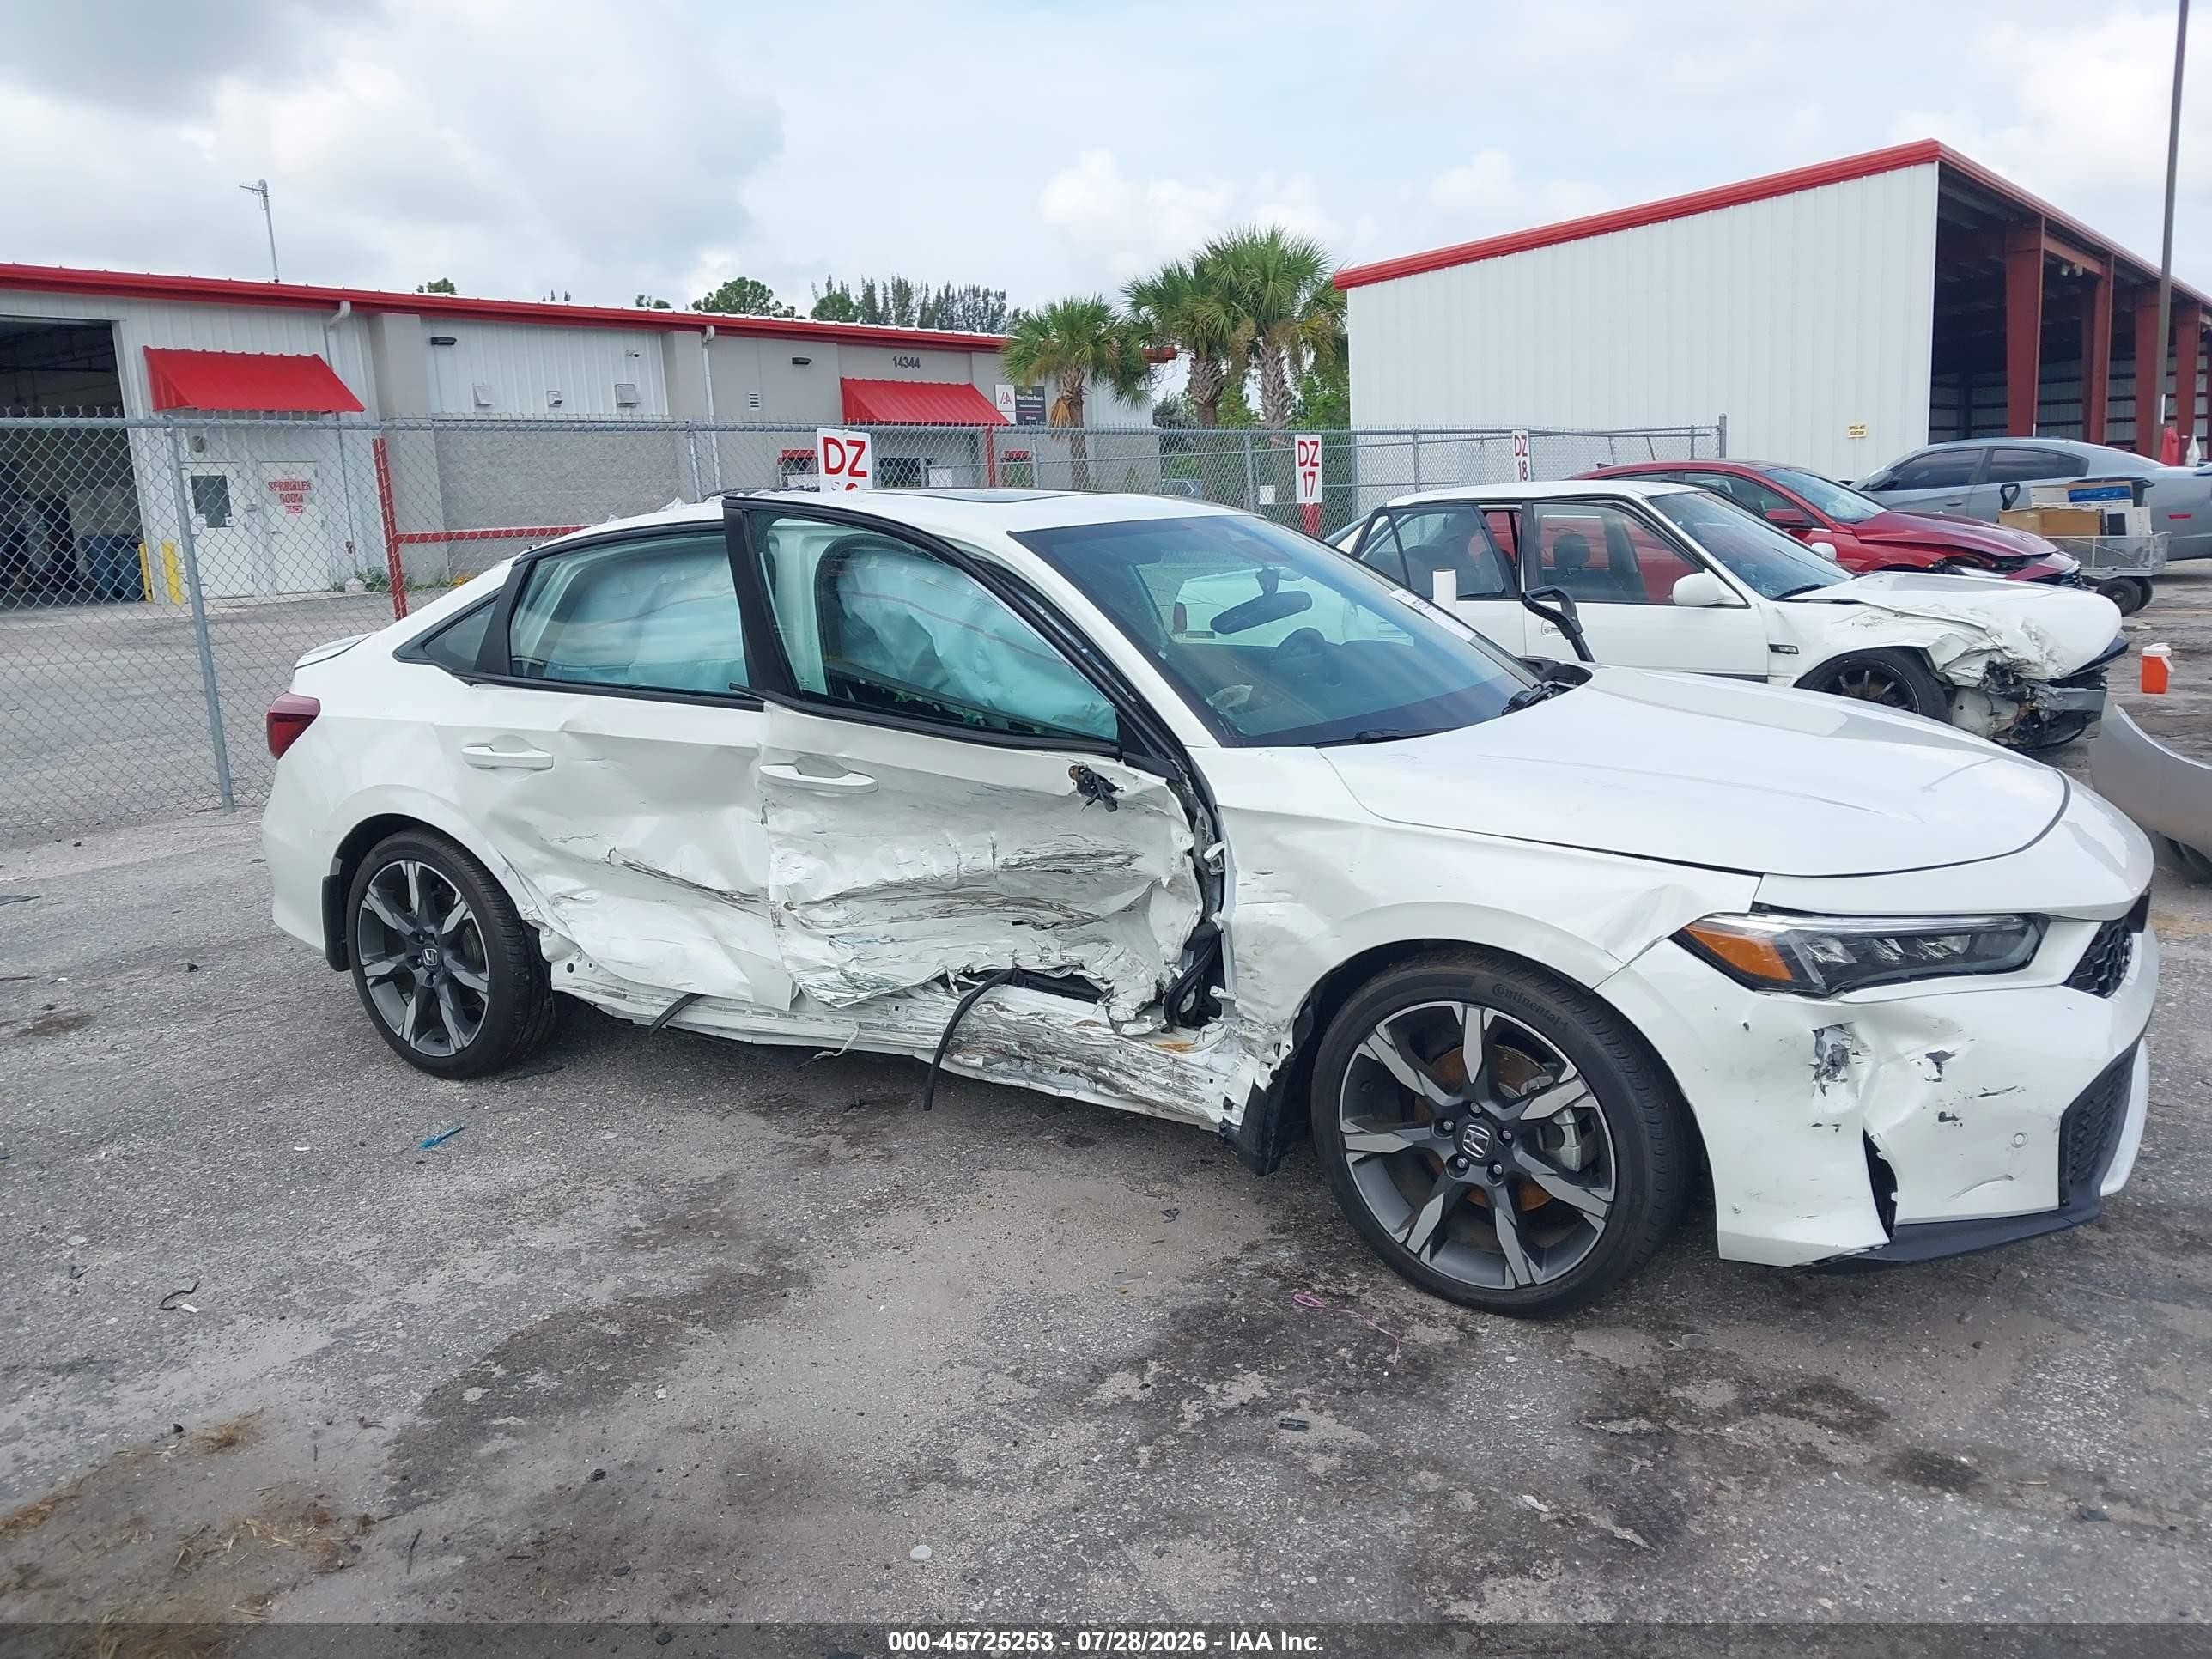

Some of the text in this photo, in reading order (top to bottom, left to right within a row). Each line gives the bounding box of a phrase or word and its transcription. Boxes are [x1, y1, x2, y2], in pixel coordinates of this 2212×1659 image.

[893, 356, 921, 369] 14344
[823, 437, 867, 477] DZ
[1297, 440, 1320, 468] DZ
[1514, 434, 1528, 457] DZ
[1517, 459, 1528, 482] 18
[1303, 471, 1316, 498] 17
[1492, 983, 1562, 1026] Continental
